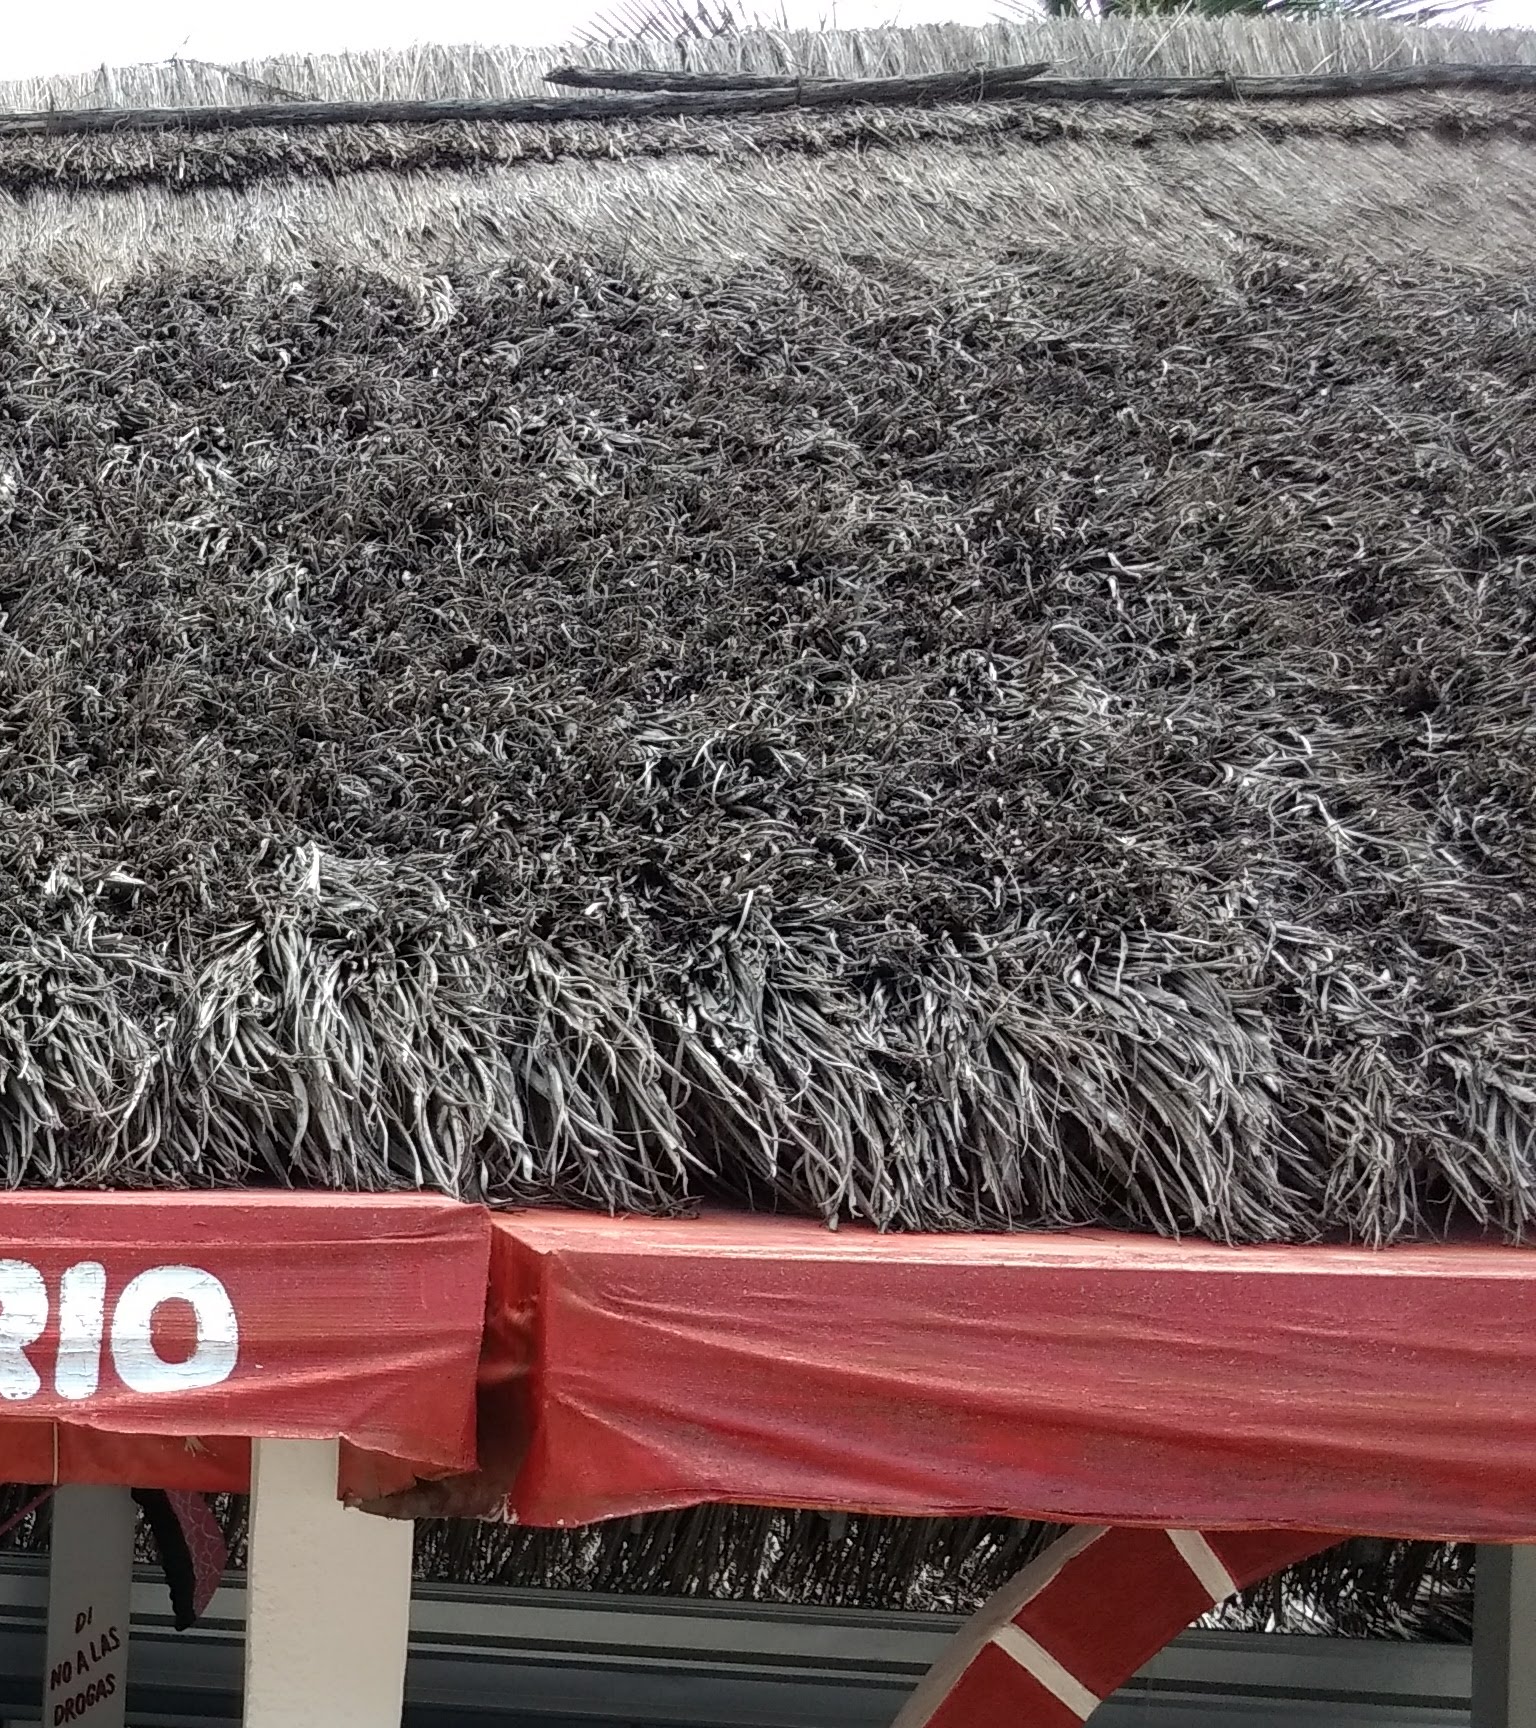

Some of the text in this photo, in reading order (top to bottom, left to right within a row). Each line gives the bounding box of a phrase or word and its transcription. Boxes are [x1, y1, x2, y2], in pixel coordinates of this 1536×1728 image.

[75, 1606, 93, 1634] DI
[51, 1626, 121, 1690] NO A LAS
[54, 1673, 116, 1727] DROGAS
